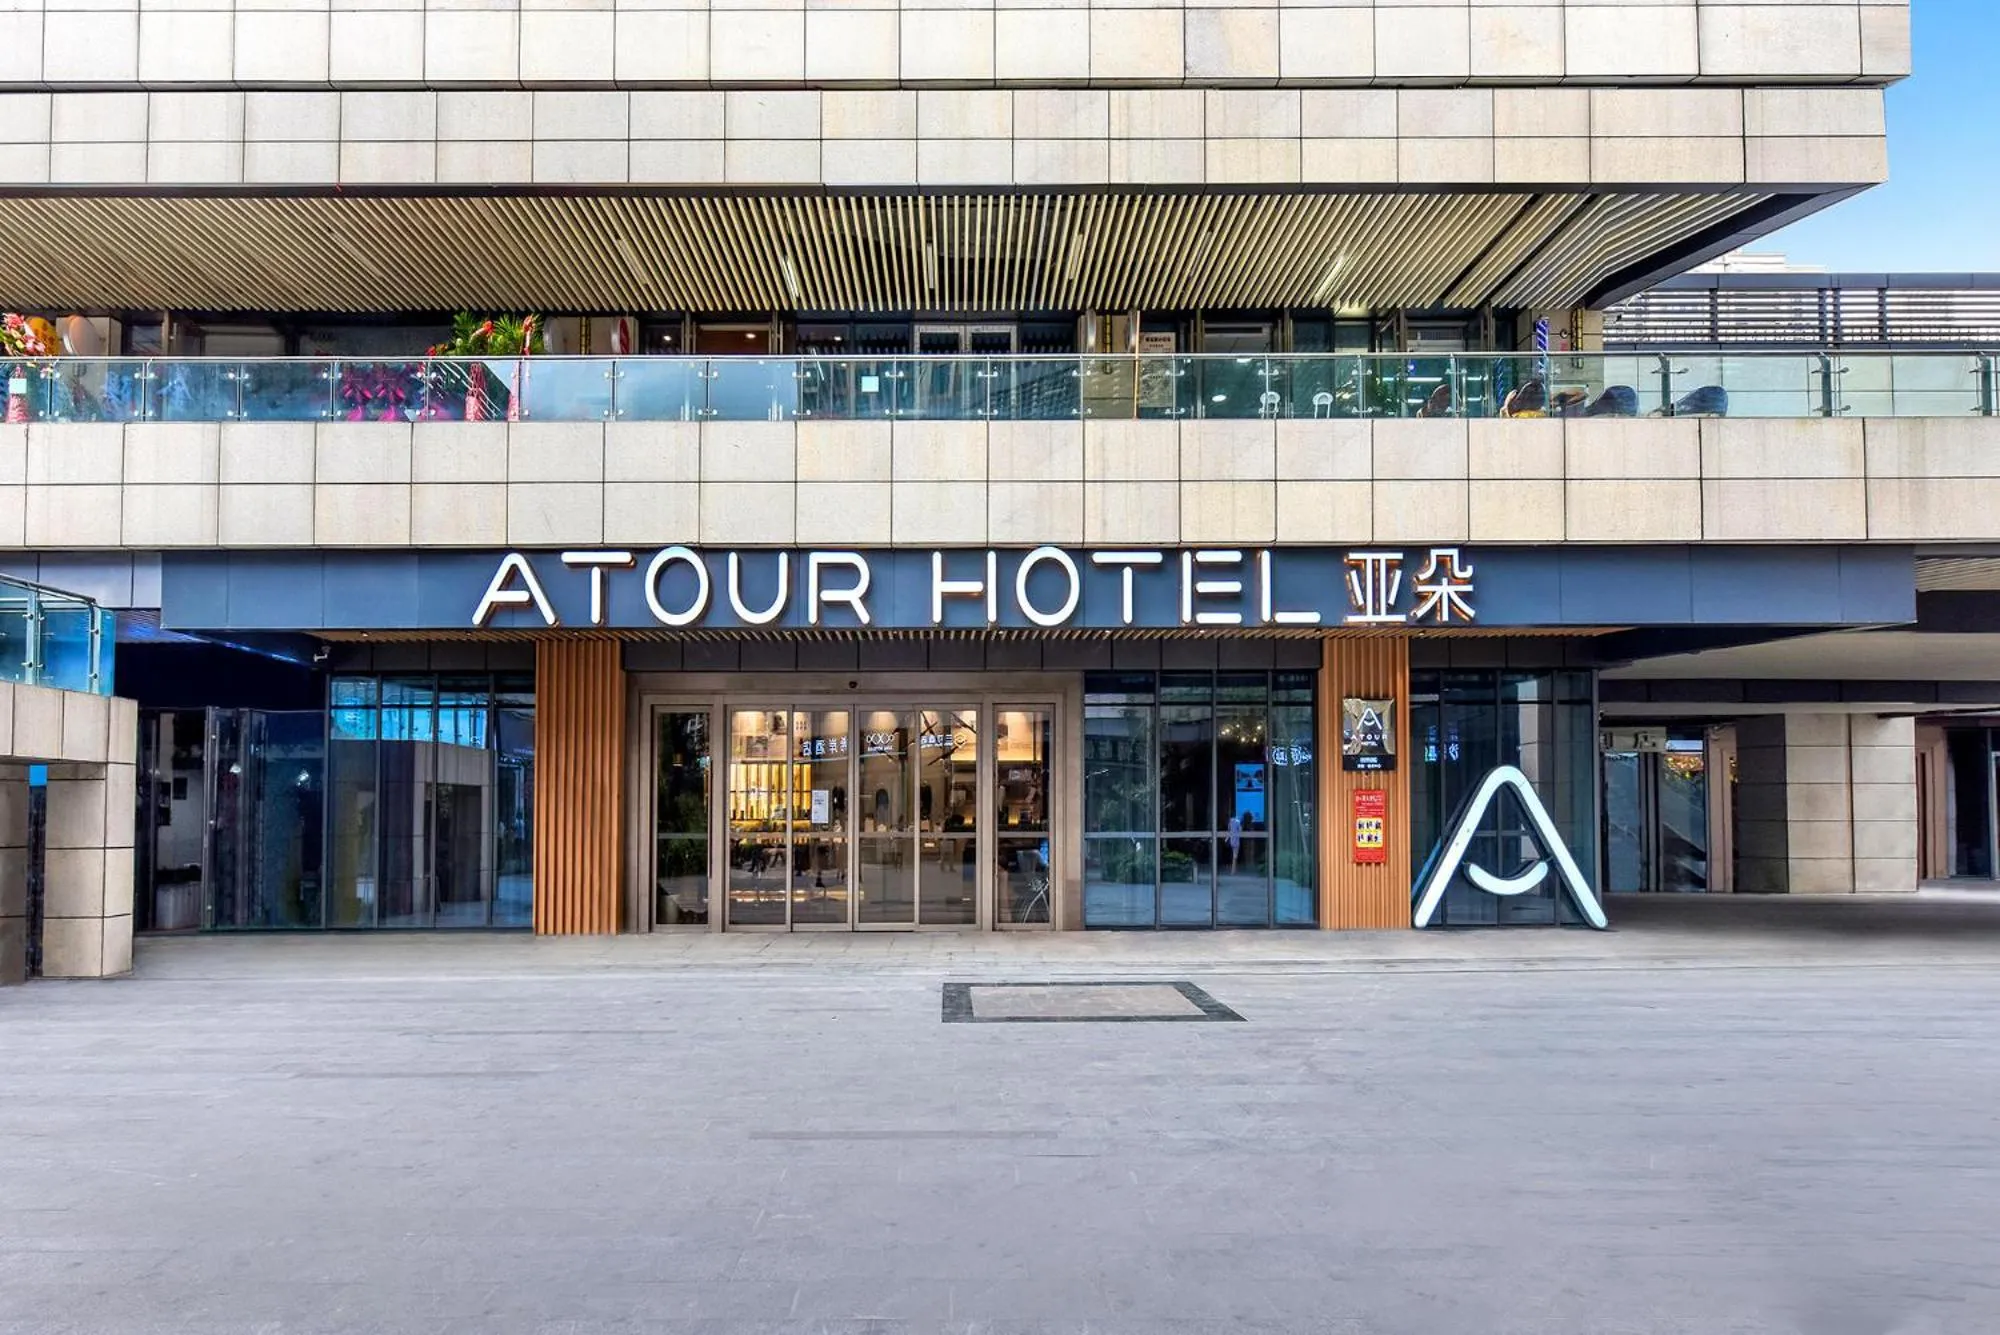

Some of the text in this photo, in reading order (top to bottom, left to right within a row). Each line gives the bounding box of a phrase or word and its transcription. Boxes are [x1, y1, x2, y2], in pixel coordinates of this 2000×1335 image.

[471, 546, 1477, 629] ATOUR HOTEL 亚朵
